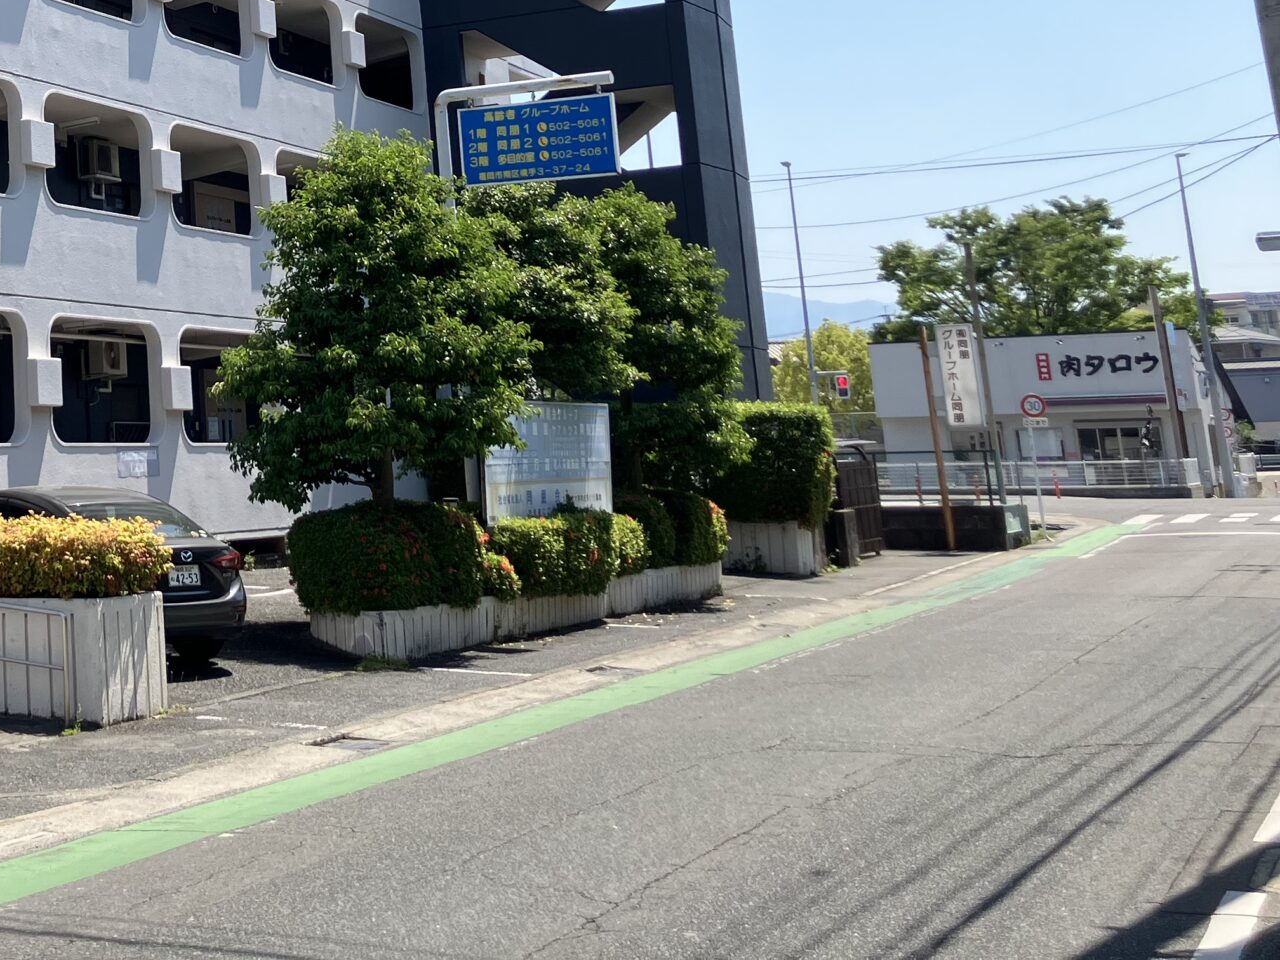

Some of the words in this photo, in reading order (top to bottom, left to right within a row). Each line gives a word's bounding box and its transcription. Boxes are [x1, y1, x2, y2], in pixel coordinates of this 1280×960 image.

[521, 103, 590, 118] グループホーム
[548, 118, 606, 131] 502-5061
[549, 132, 607, 146] 502-5061
[551, 146, 609, 160] 502-5061
[1058, 351, 1160, 377] 肉タロウ
[1026, 400, 1041, 412] 30
[176, 573, 199, 584] 42-53
